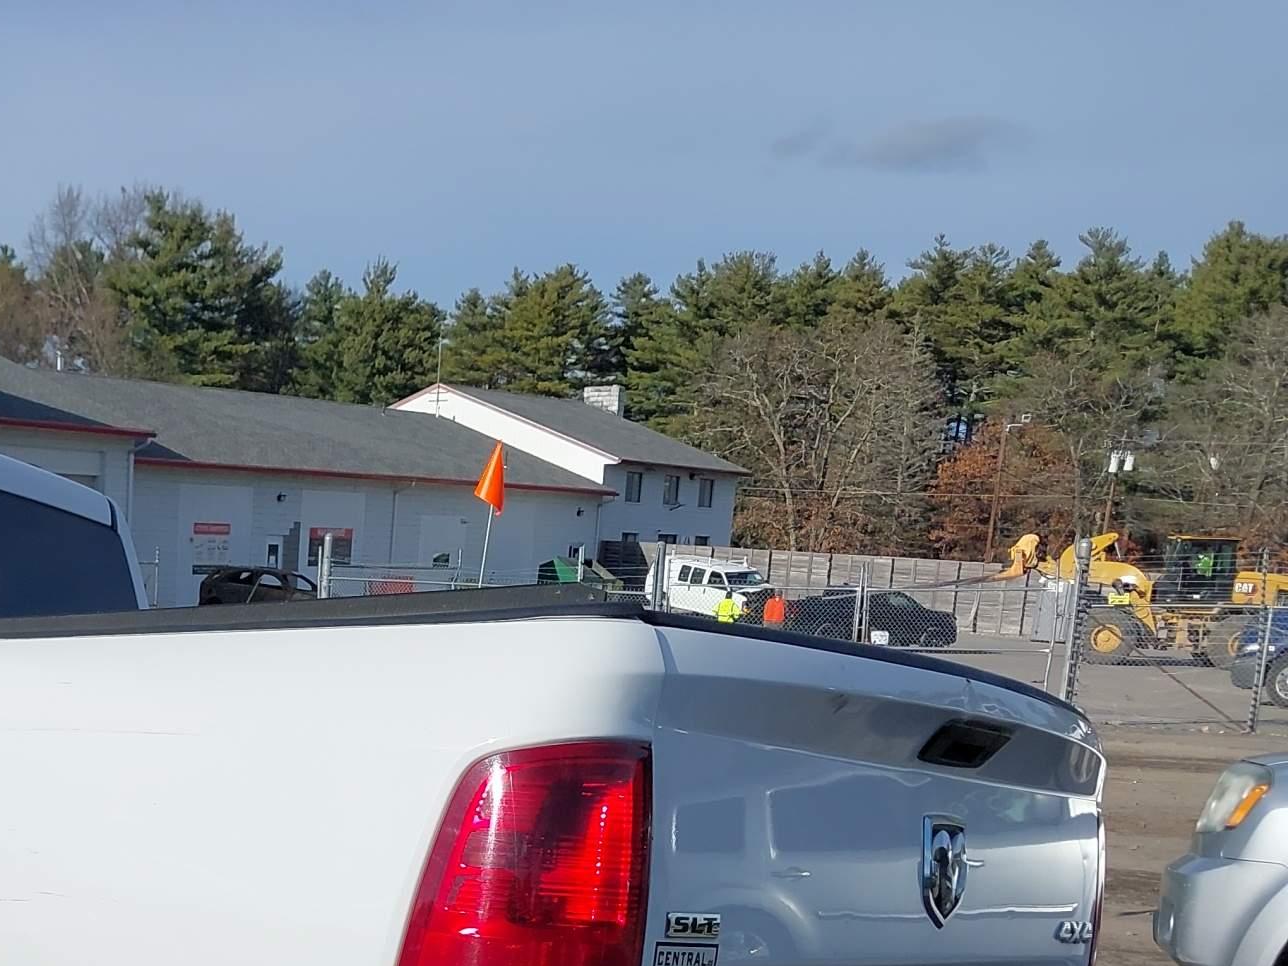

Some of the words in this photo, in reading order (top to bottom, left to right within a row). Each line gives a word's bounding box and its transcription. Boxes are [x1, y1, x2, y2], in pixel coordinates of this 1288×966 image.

[1234, 582, 1255, 594] CAT
[672, 916, 718, 934] SLT
[657, 951, 707, 966] CENTRAL
